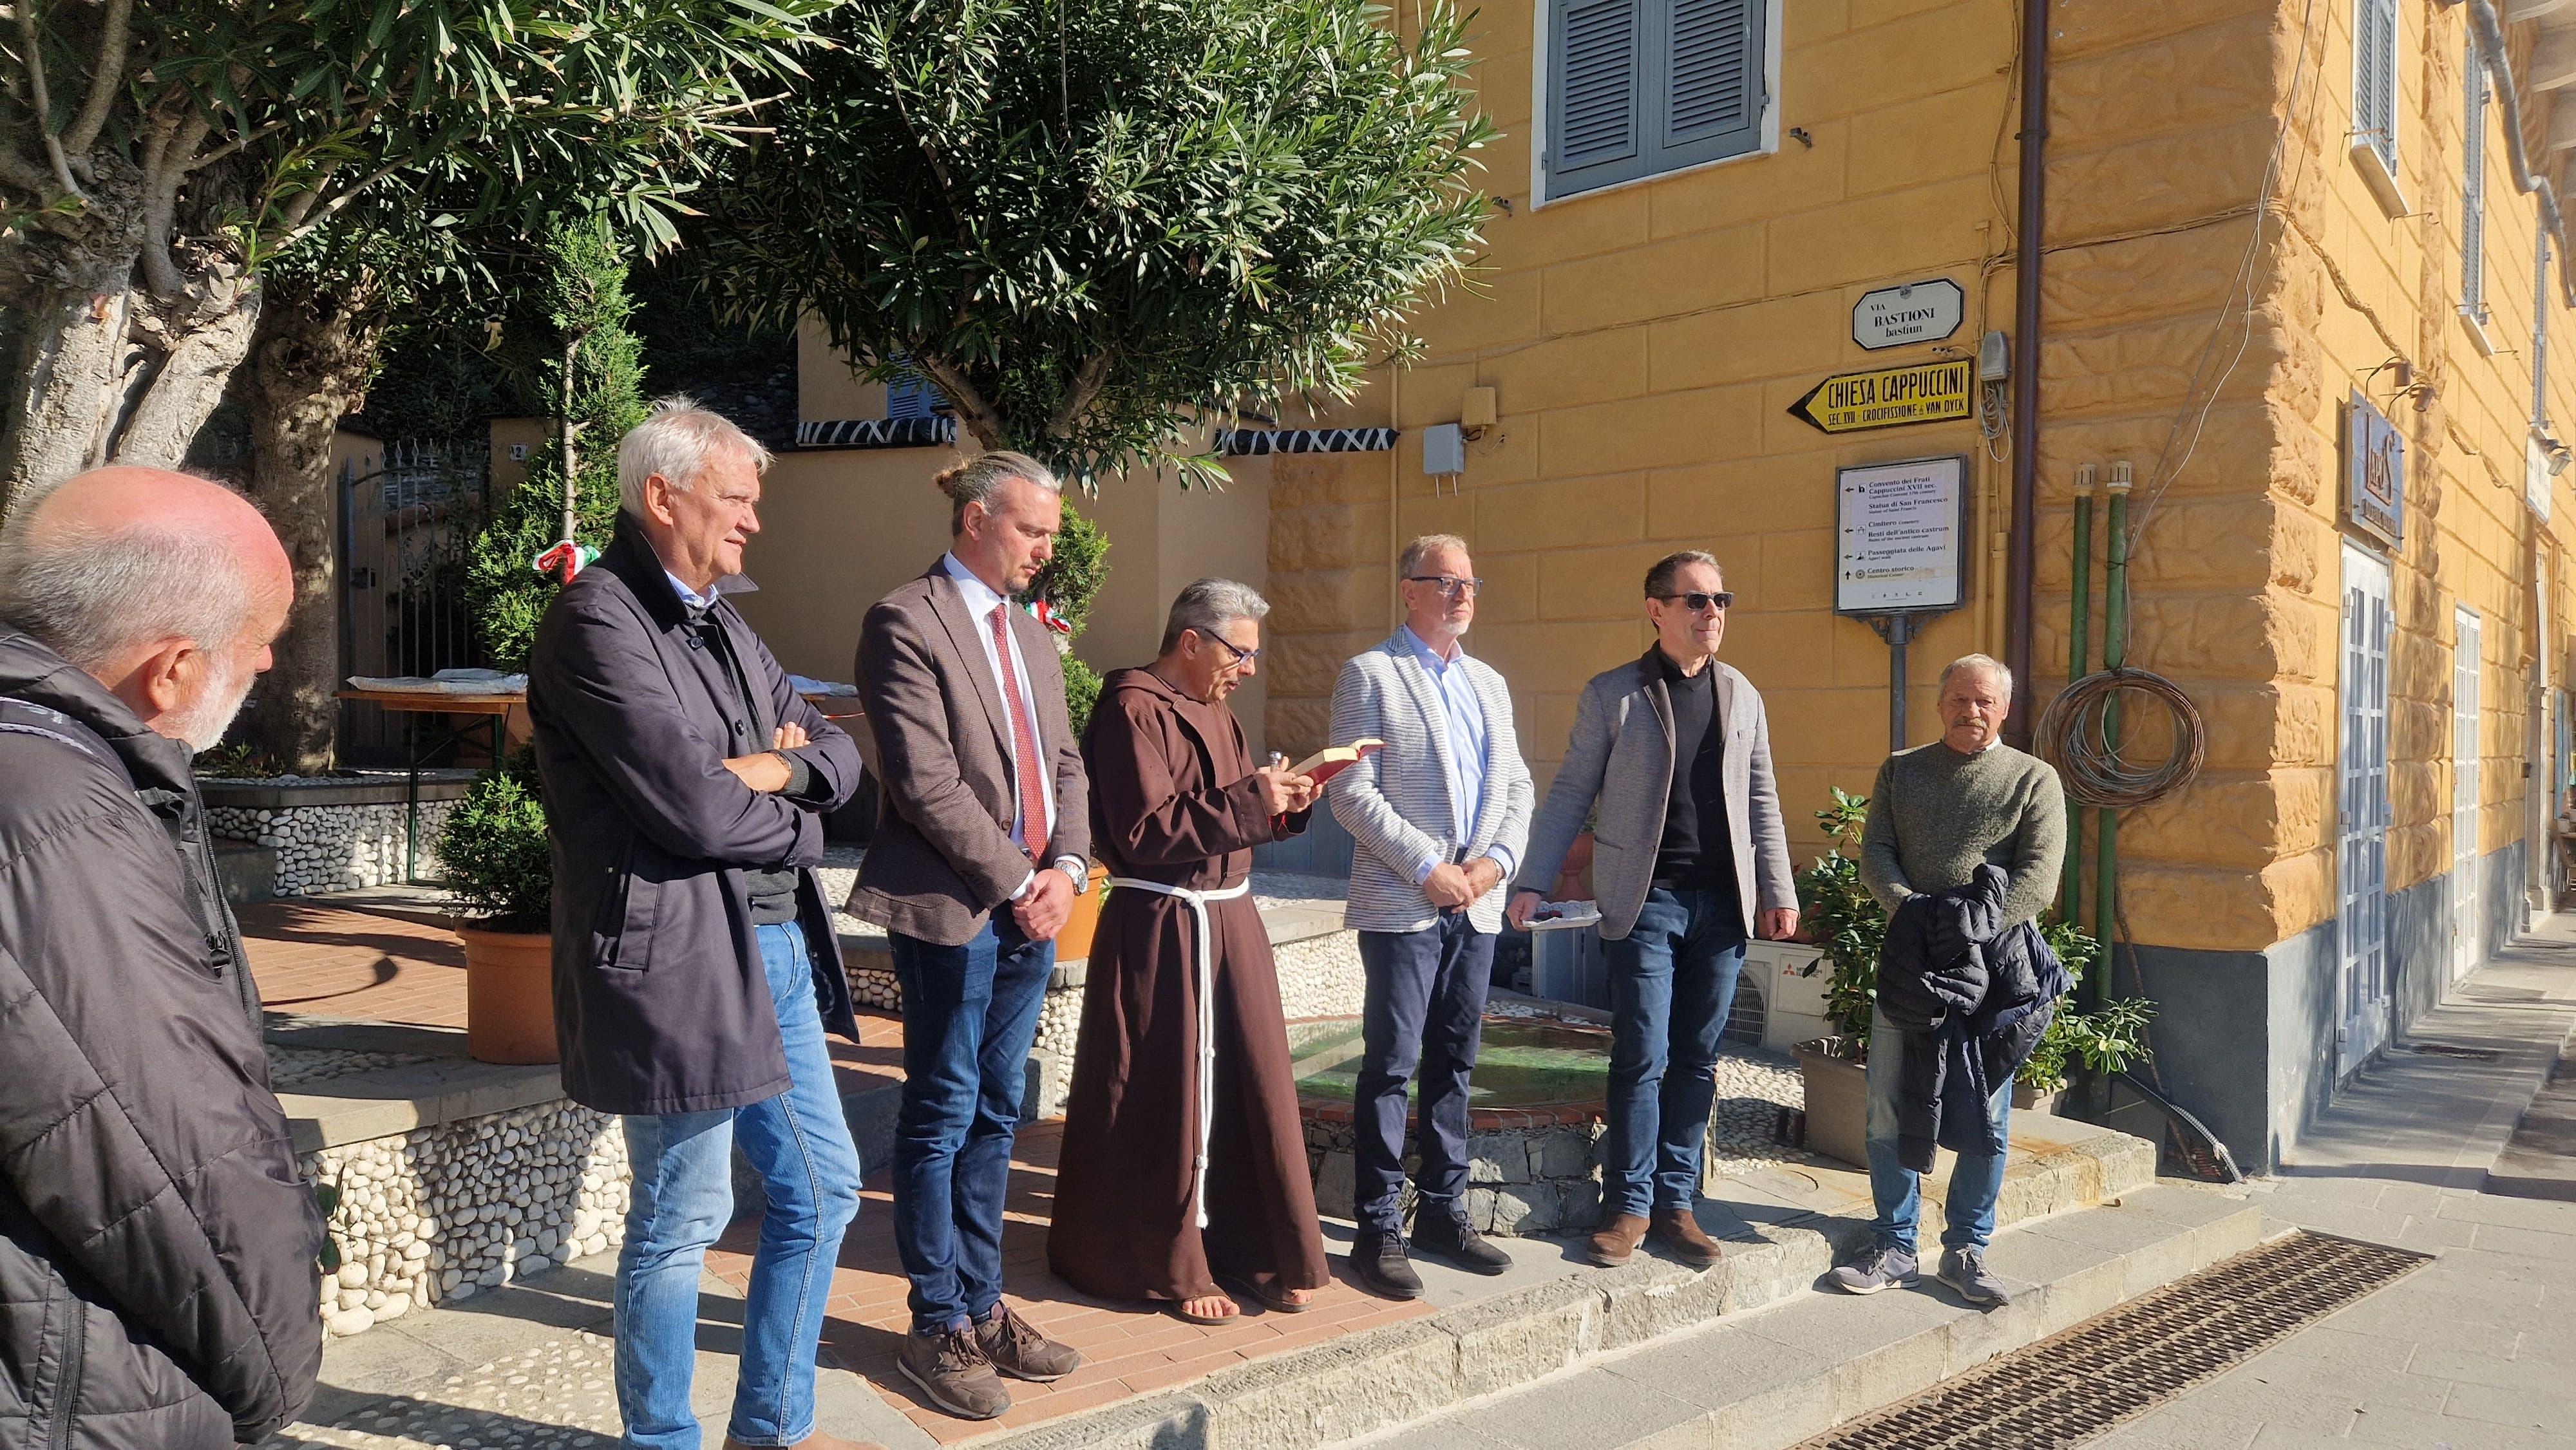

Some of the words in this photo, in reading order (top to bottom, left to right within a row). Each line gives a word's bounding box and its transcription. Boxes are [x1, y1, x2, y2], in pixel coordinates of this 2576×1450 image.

[1875, 308, 1935, 327] BASTIONI
[1828, 379, 1875, 409] CHIESA
[1882, 366, 1964, 402] CAPPUCCINI
[1844, 411, 1855, 424] XVII
[1863, 404, 1917, 422] CROCIFISSIONE
[1926, 401, 1940, 414] VAN
[1945, 398, 1964, 412] DYCK
[1869, 480, 1900, 488] Convento
[1869, 486, 1906, 494] Cappuccini
[1868, 547, 1906, 556] Passeggiata
